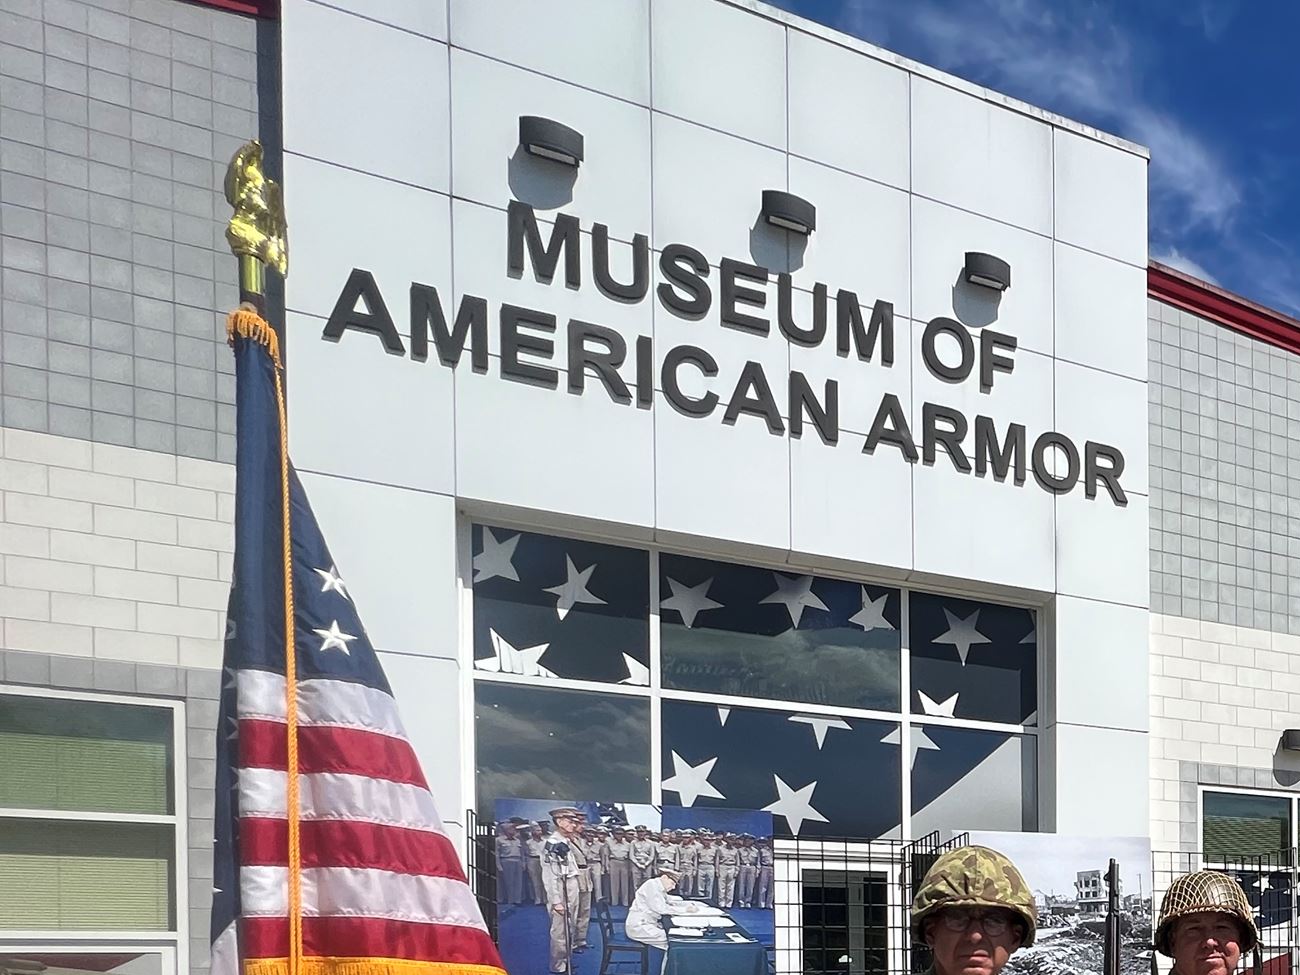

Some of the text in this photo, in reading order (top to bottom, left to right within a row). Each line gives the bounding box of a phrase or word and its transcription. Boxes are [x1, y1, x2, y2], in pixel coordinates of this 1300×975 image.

[321, 267, 1129, 506] AMERICAN ARMOR
[505, 198, 1018, 394] MUSEUM OF
